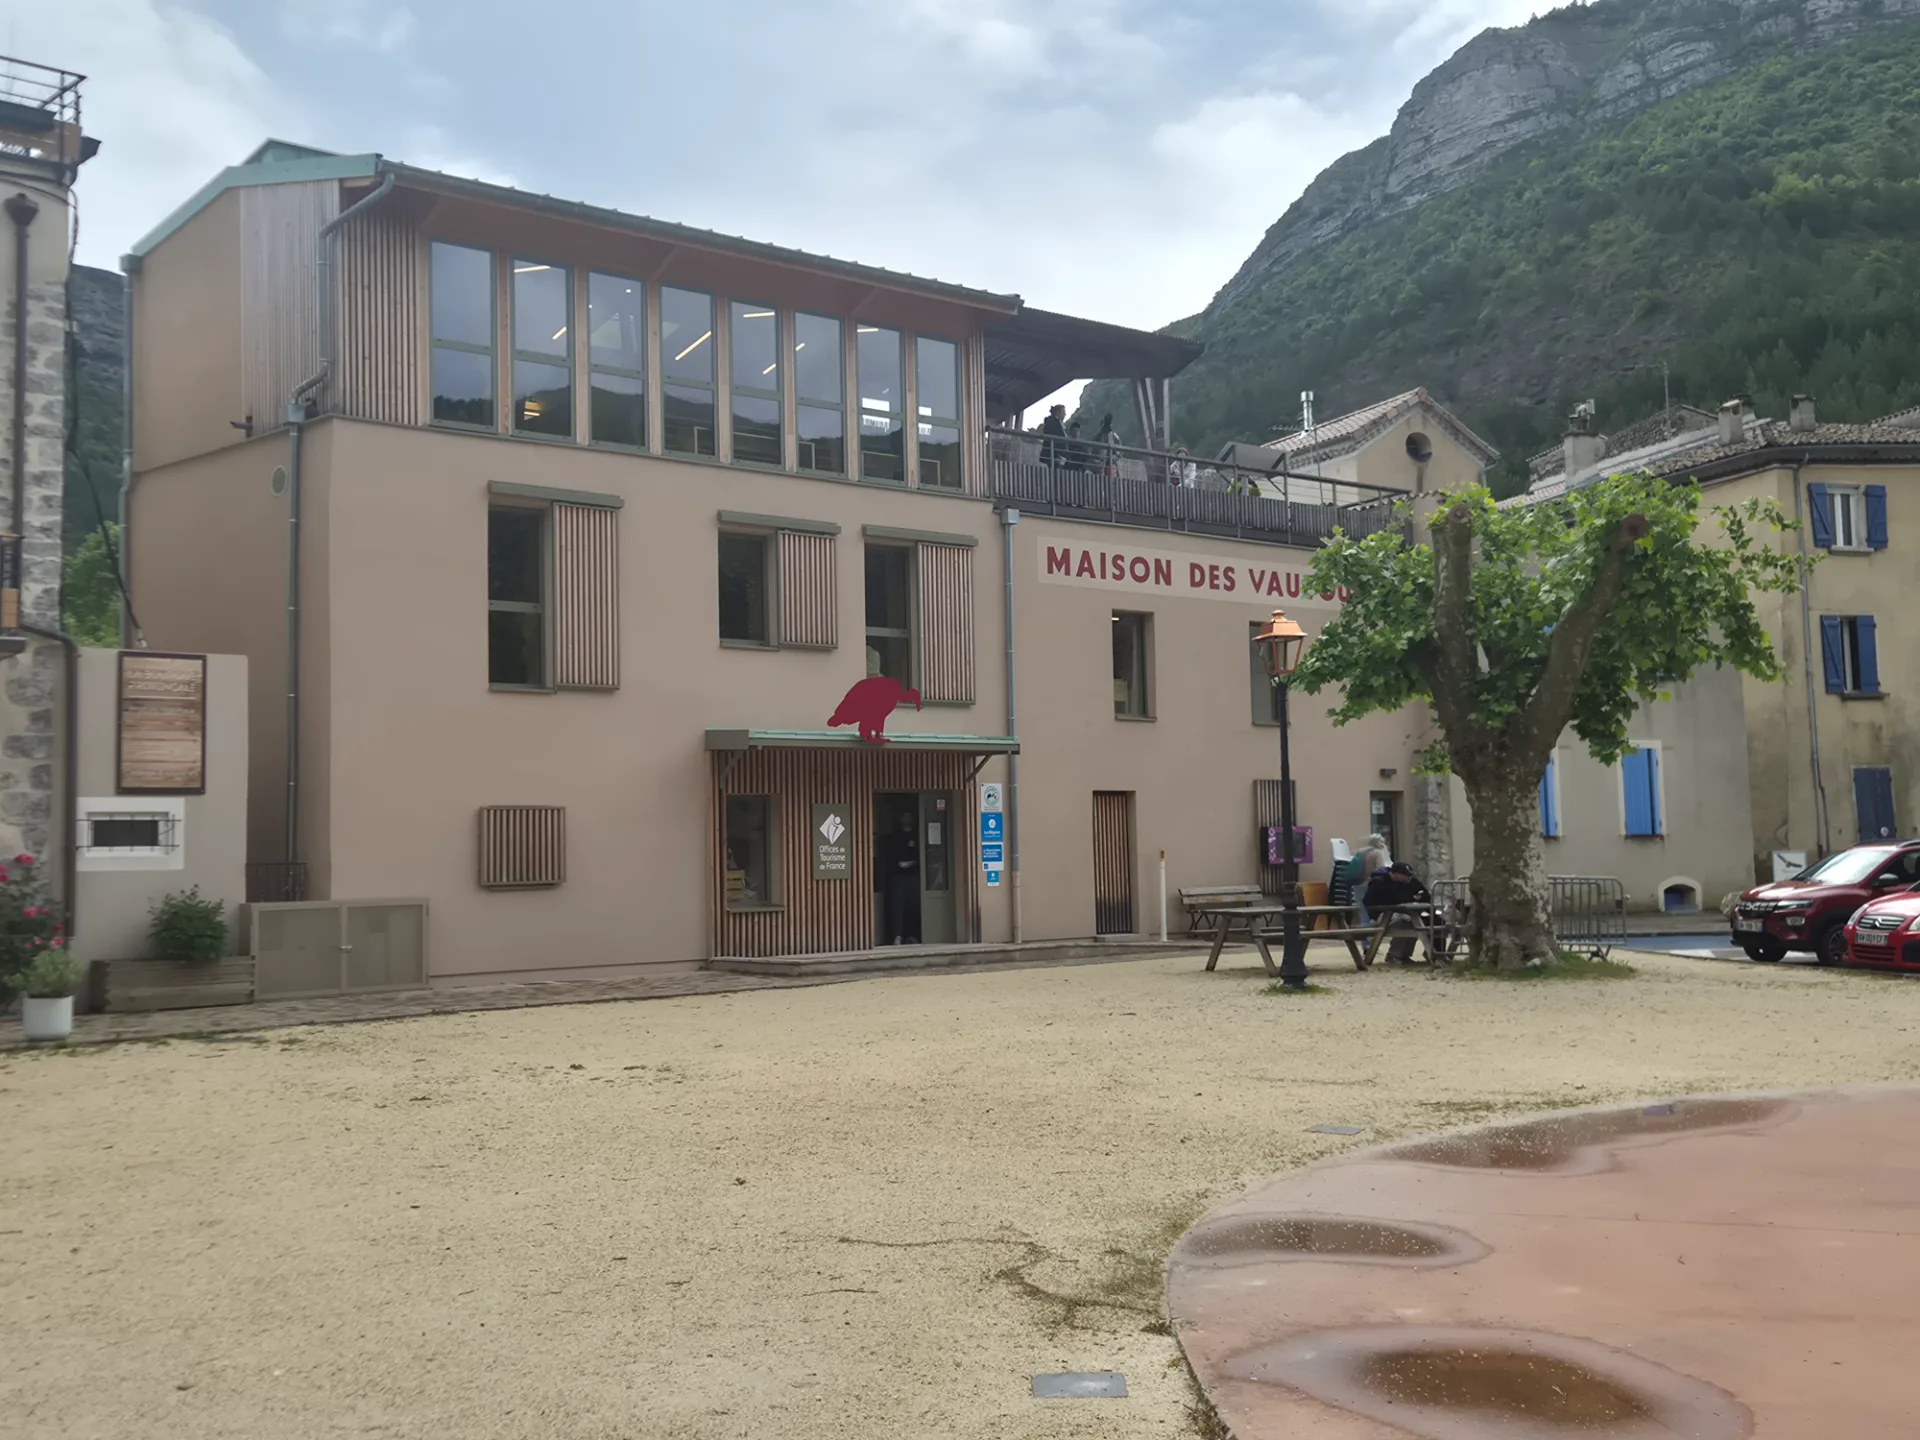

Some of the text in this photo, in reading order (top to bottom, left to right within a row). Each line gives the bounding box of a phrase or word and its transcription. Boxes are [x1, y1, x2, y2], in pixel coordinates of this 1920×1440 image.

[1046, 545, 1173, 587] MAISON
[1189, 562, 1236, 592] DES
[819, 845, 839, 853] Offices
[819, 853, 846, 861] Tourisme
[826, 862, 846, 870] France
